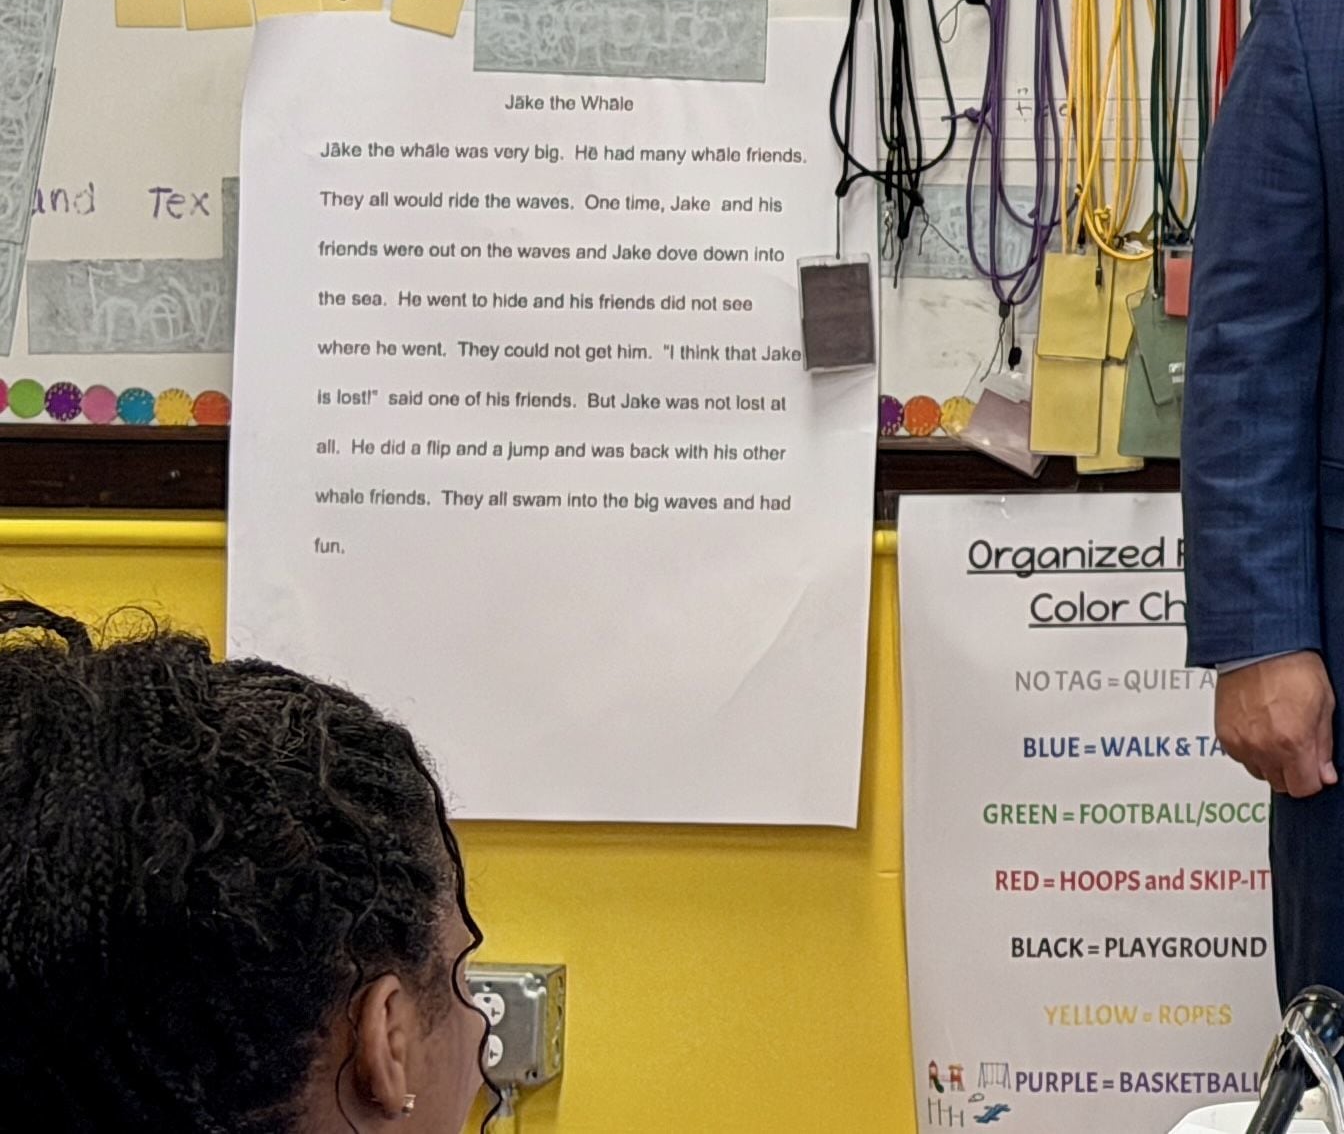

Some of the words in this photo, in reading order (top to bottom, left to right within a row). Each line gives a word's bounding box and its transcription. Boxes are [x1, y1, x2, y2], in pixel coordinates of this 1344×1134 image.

[550, 95, 575, 110] the
[320, 191, 364, 210] They
[369, 192, 388, 206] all
[394, 192, 443, 207] would
[449, 192, 479, 208] ride
[485, 193, 510, 208] the
[585, 194, 620, 210] One
[670, 196, 710, 211] Jake
[721, 197, 752, 211] and
[759, 197, 782, 212] his
[969, 537, 1165, 578] Organized
[1030, 591, 1128, 623] Color
[1014, 672, 1050, 691] NO
[1055, 671, 1102, 691] TAG
[1124, 671, 1198, 692] QUIET
[1023, 738, 1079, 758] BLUE
[1101, 738, 1170, 757] WALK
[1175, 738, 1191, 757] &
[983, 804, 1057, 824] GREEN
[1079, 802, 1270, 826] FOOTBALL/SOCC
[996, 871, 1039, 891] RED
[1060, 871, 1140, 891] HOOPS
[1145, 870, 1185, 890] and
[1190, 871, 1269, 890] SKIP-IT
[1011, 938, 1083, 958] BLACK
[1105, 938, 1267, 958] PLAYGROUND
[1044, 1005, 1138, 1025] YELLOW
[1159, 1005, 1232, 1025] ROPES
[1015, 1072, 1098, 1093] PURPLE
[1119, 1072, 1264, 1093] BASKETBALL
